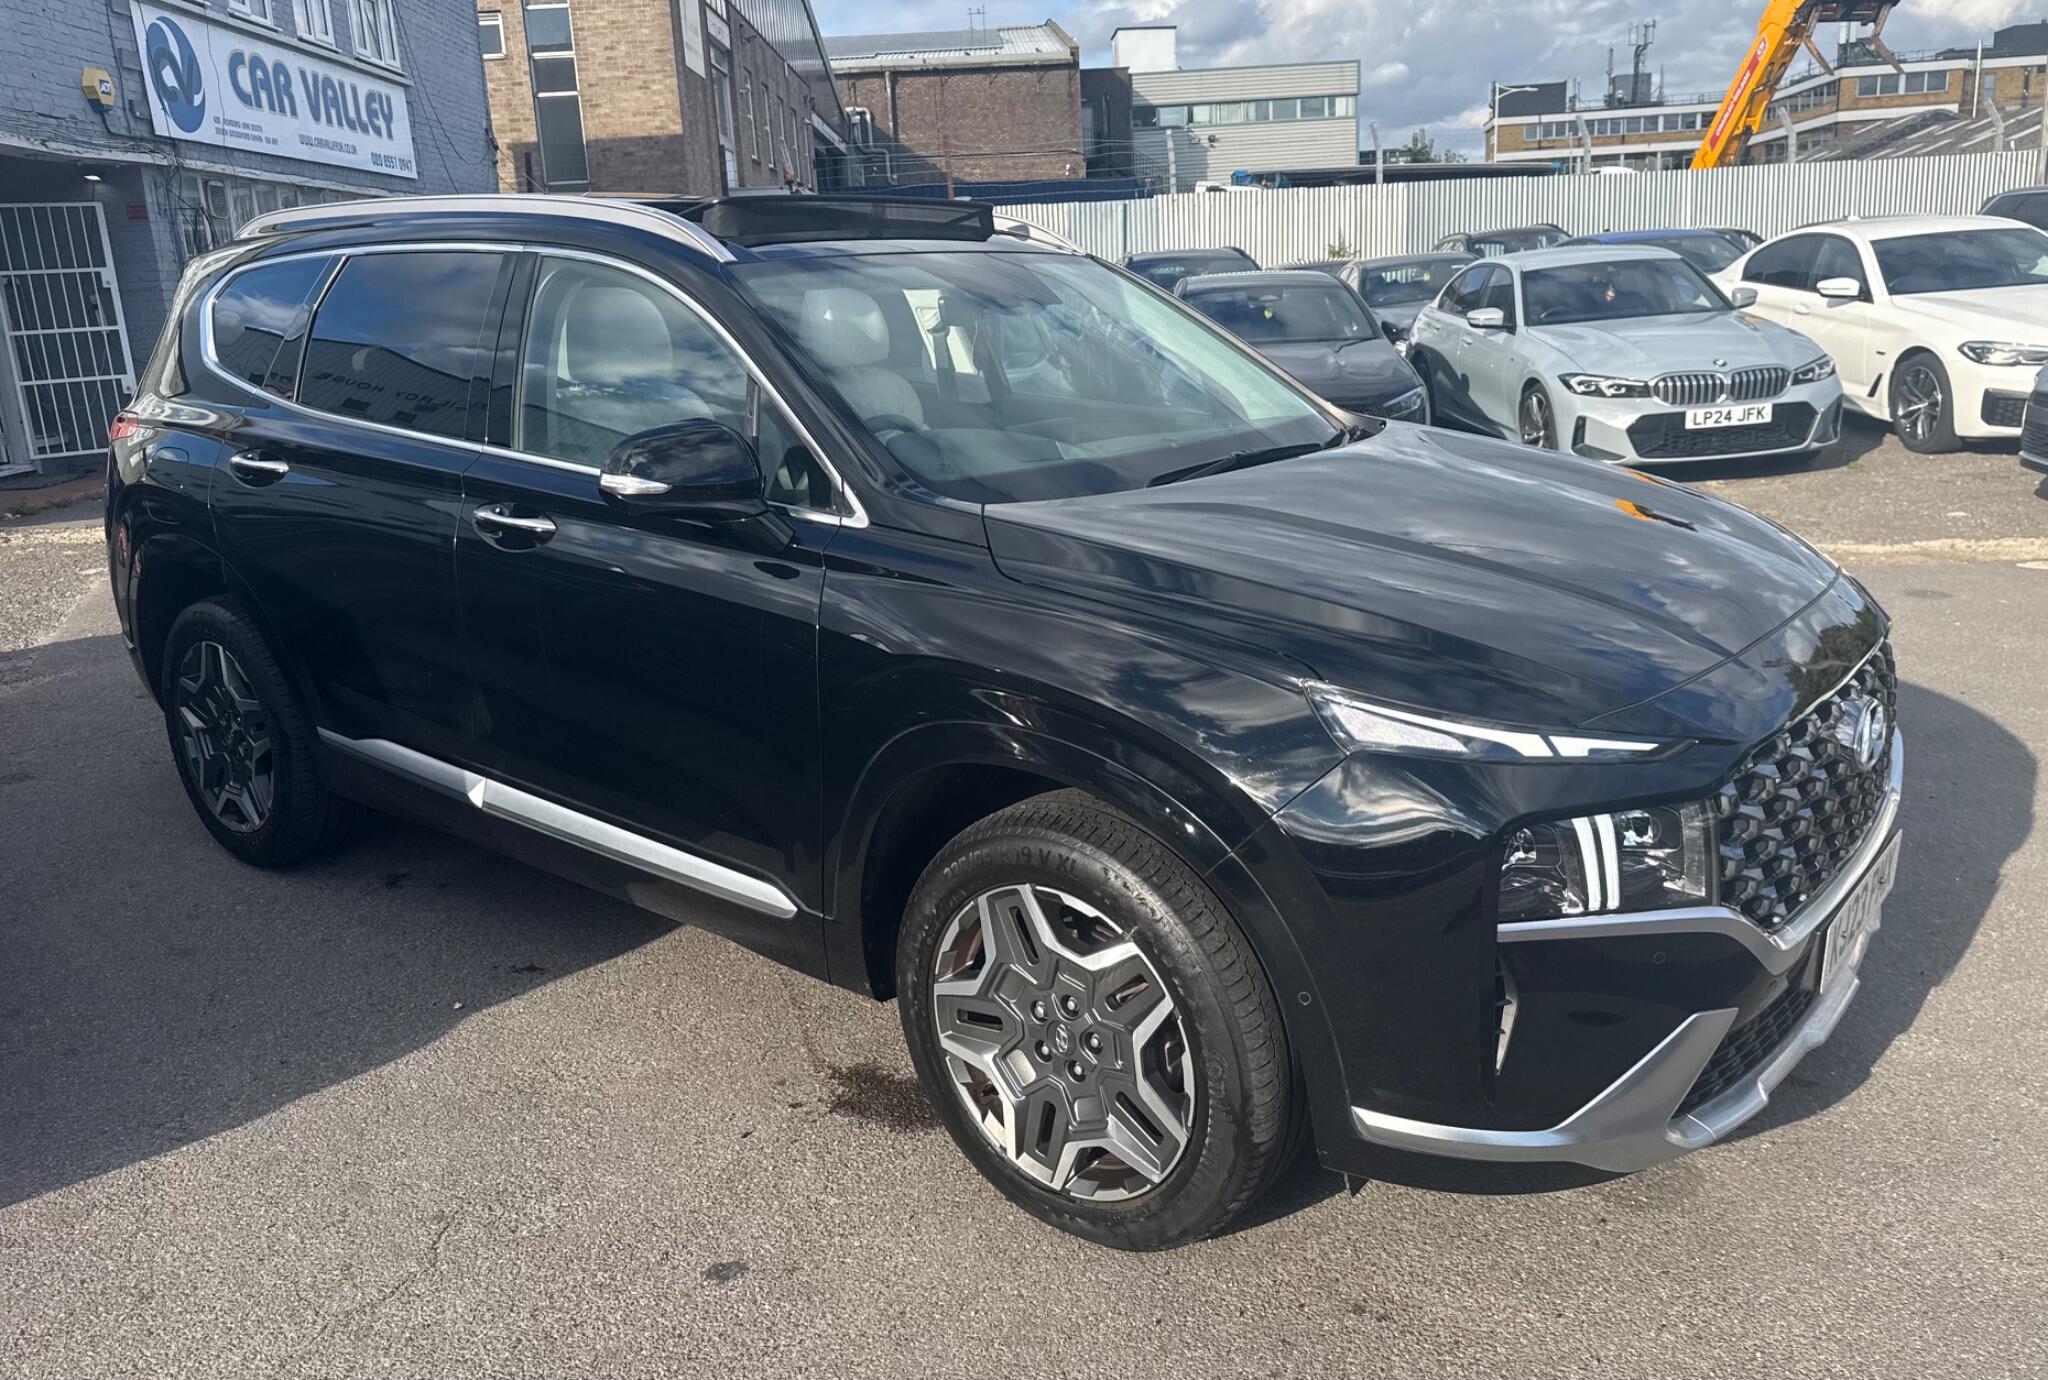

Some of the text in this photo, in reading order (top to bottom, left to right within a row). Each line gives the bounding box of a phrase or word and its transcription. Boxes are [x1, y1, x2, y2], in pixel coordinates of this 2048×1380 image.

[228, 48, 394, 141] CAR VALLEY
[1693, 406, 1766, 426] LP24 JFK
